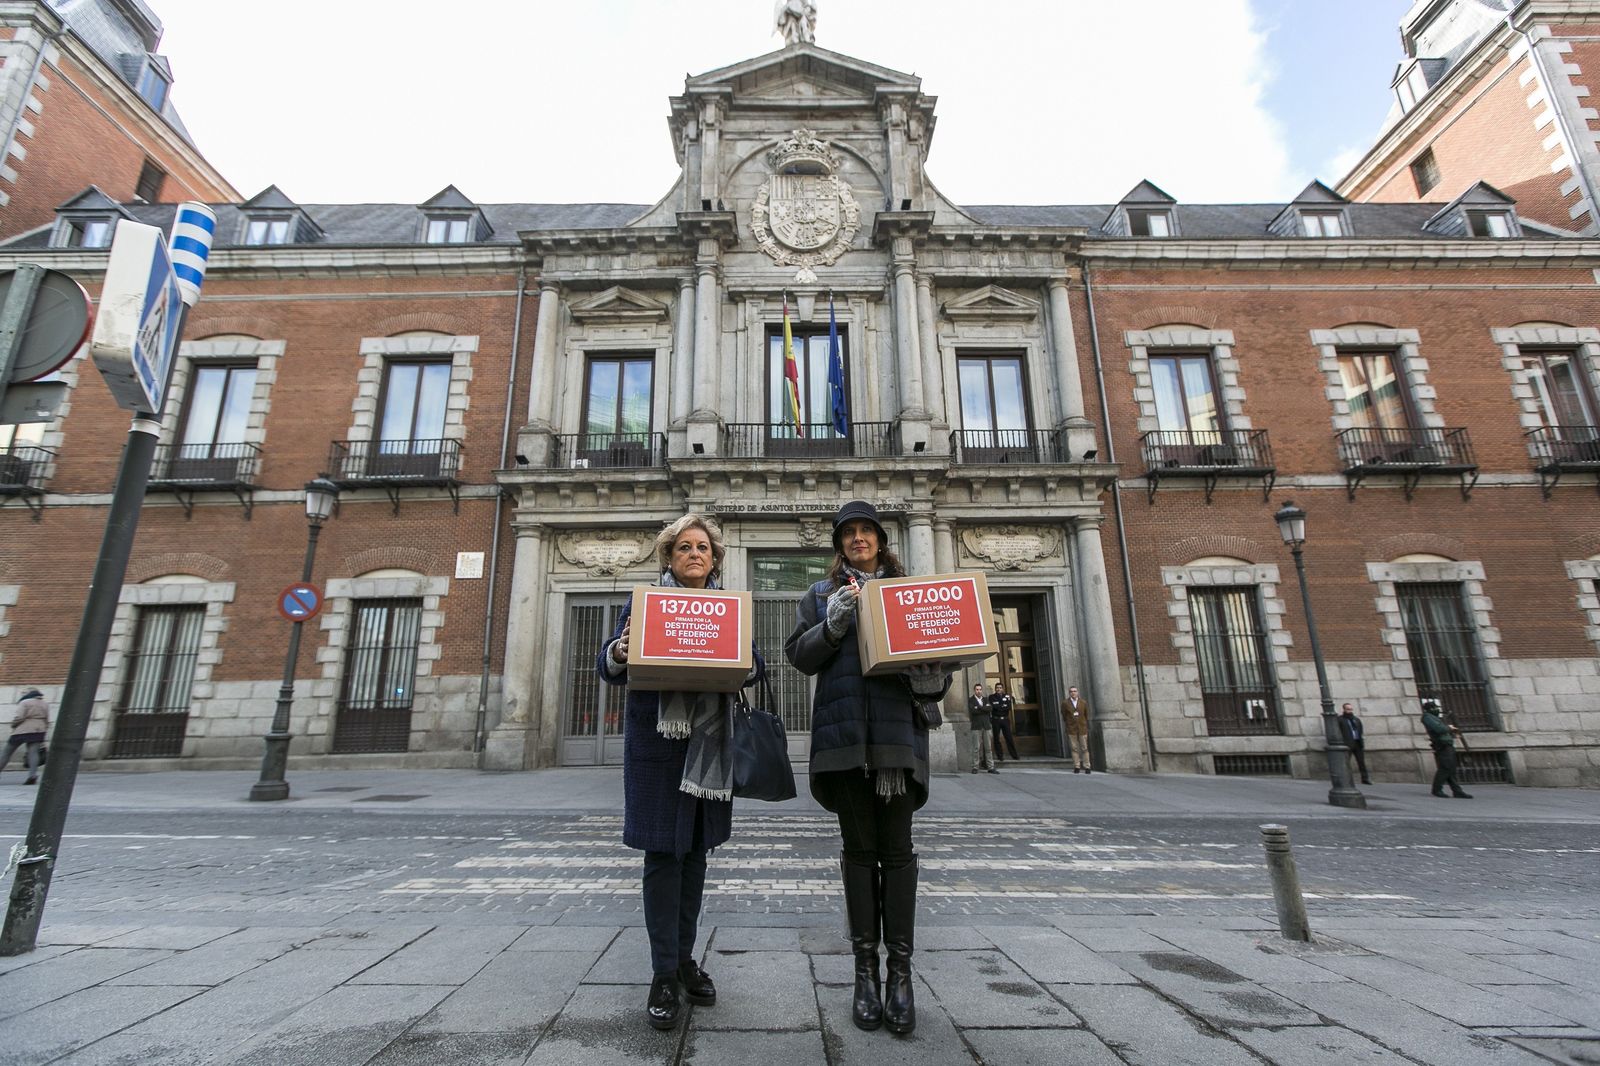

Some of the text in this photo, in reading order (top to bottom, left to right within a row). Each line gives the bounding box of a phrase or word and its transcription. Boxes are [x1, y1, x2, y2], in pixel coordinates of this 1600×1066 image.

[705, 503, 914, 512] MINISTERIO DE ASUNTOS EXTERIORES OPERACION
[896, 586, 962, 606] 137.000
[660, 600, 726, 616] 137.000
[906, 609, 960, 620] DESTITUCIÓN
[665, 622, 720, 630] DESTITUCIÓN
[908, 618, 960, 630] DE FEDERICO
[678, 630, 718, 638] FEDERICO
[921, 626, 950, 636] TRILLO
